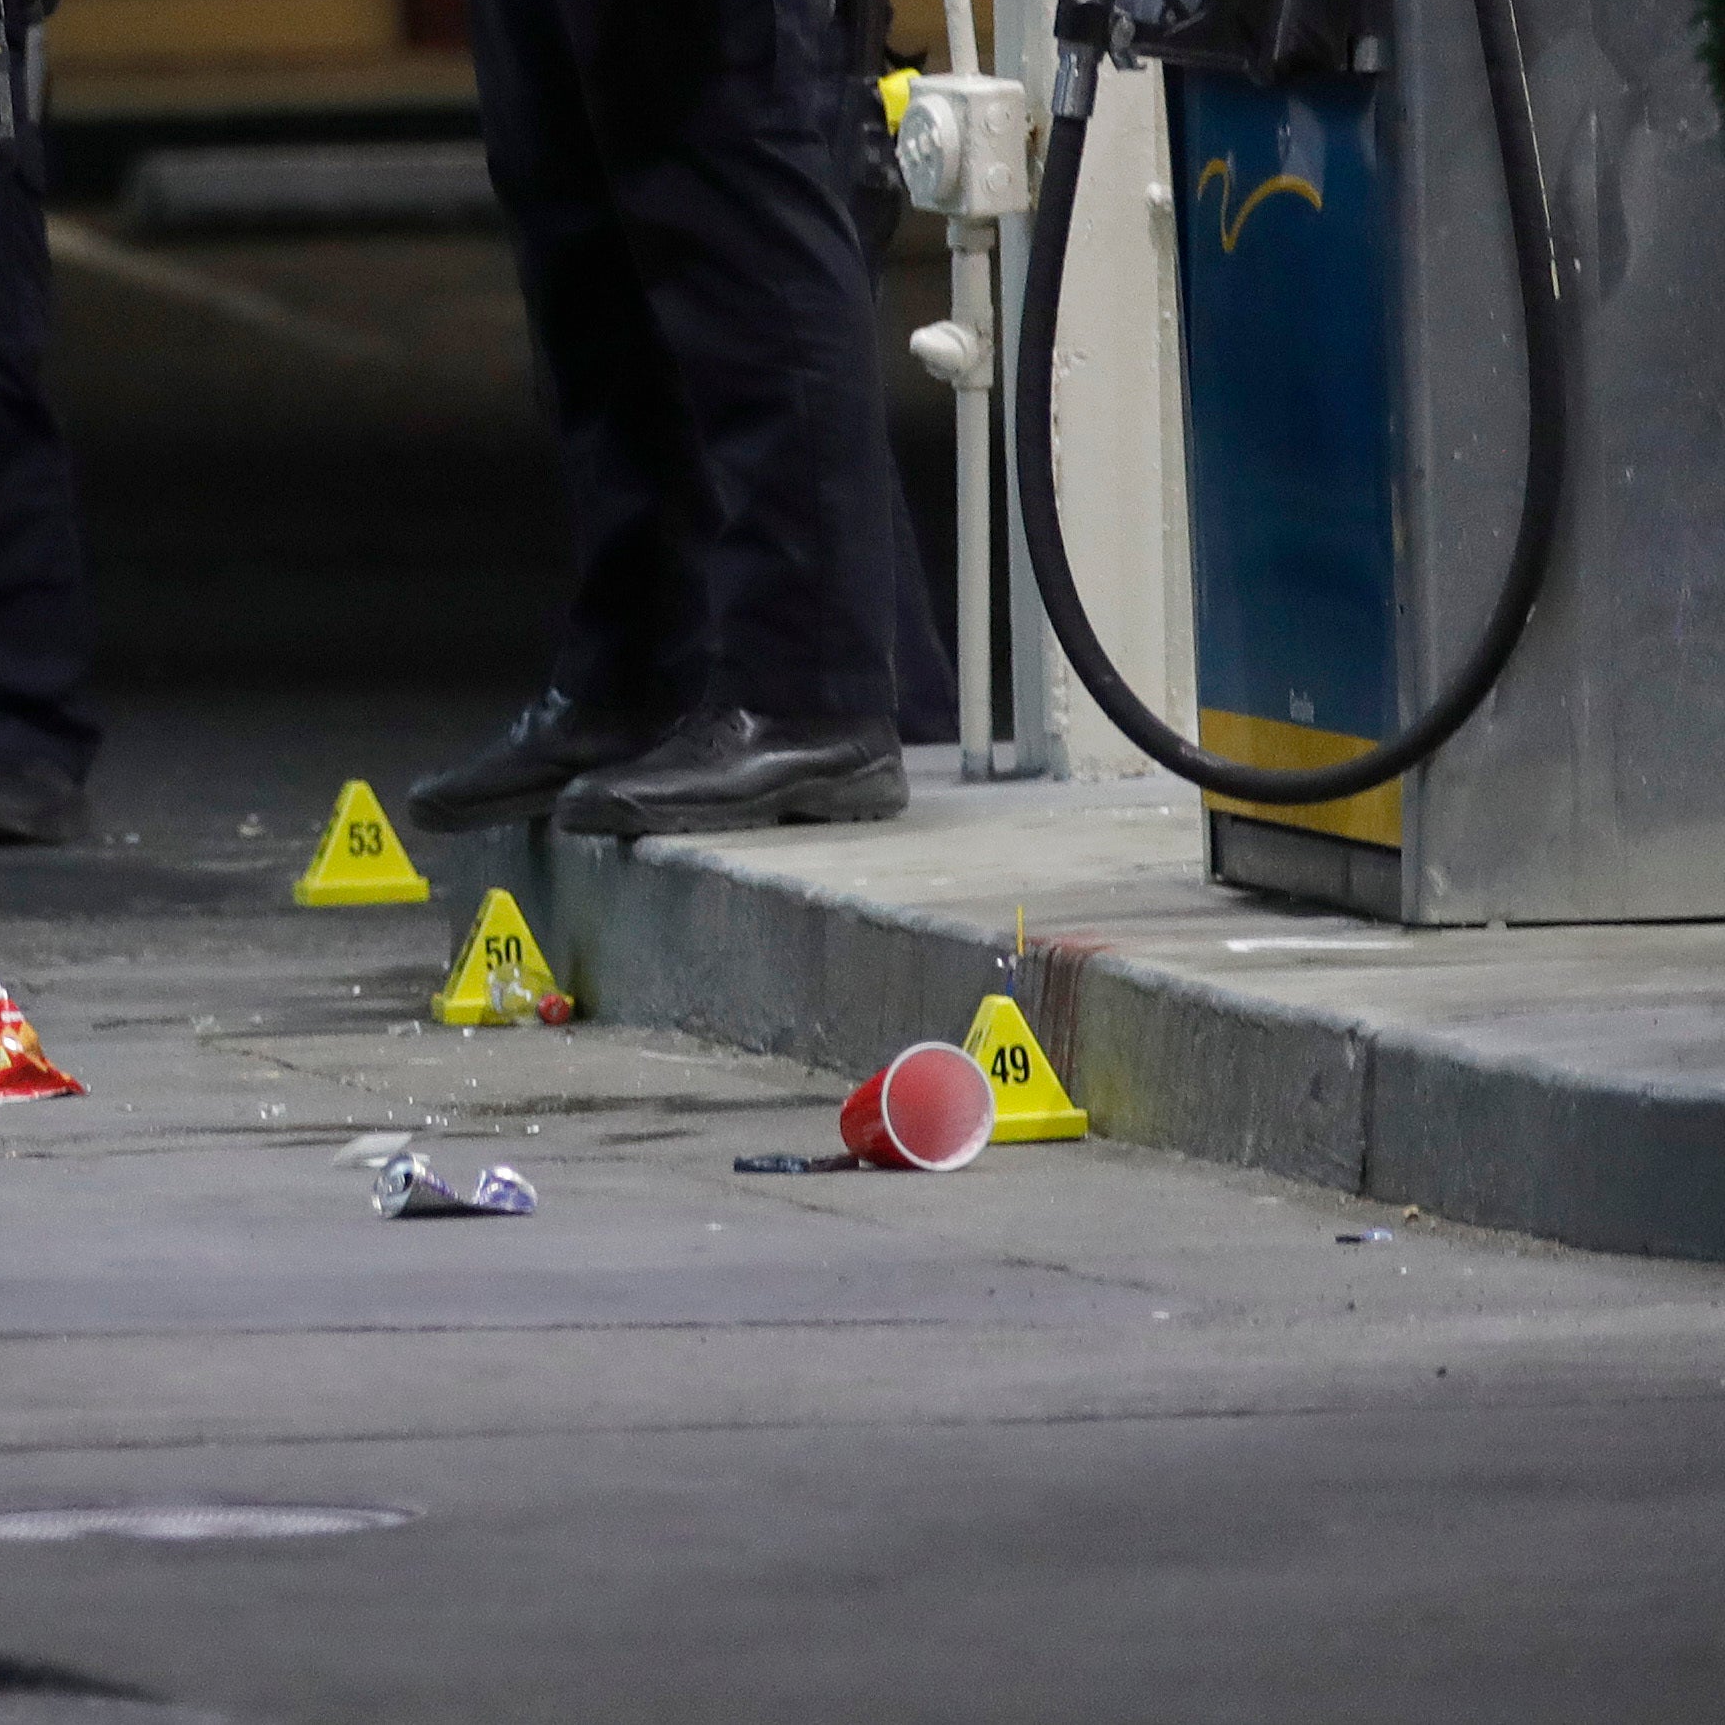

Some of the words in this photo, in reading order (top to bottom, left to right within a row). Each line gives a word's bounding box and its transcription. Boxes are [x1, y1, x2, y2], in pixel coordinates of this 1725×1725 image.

[350, 821, 383, 857] 53
[485, 935, 522, 971] 50
[990, 1045, 1031, 1084] 49
